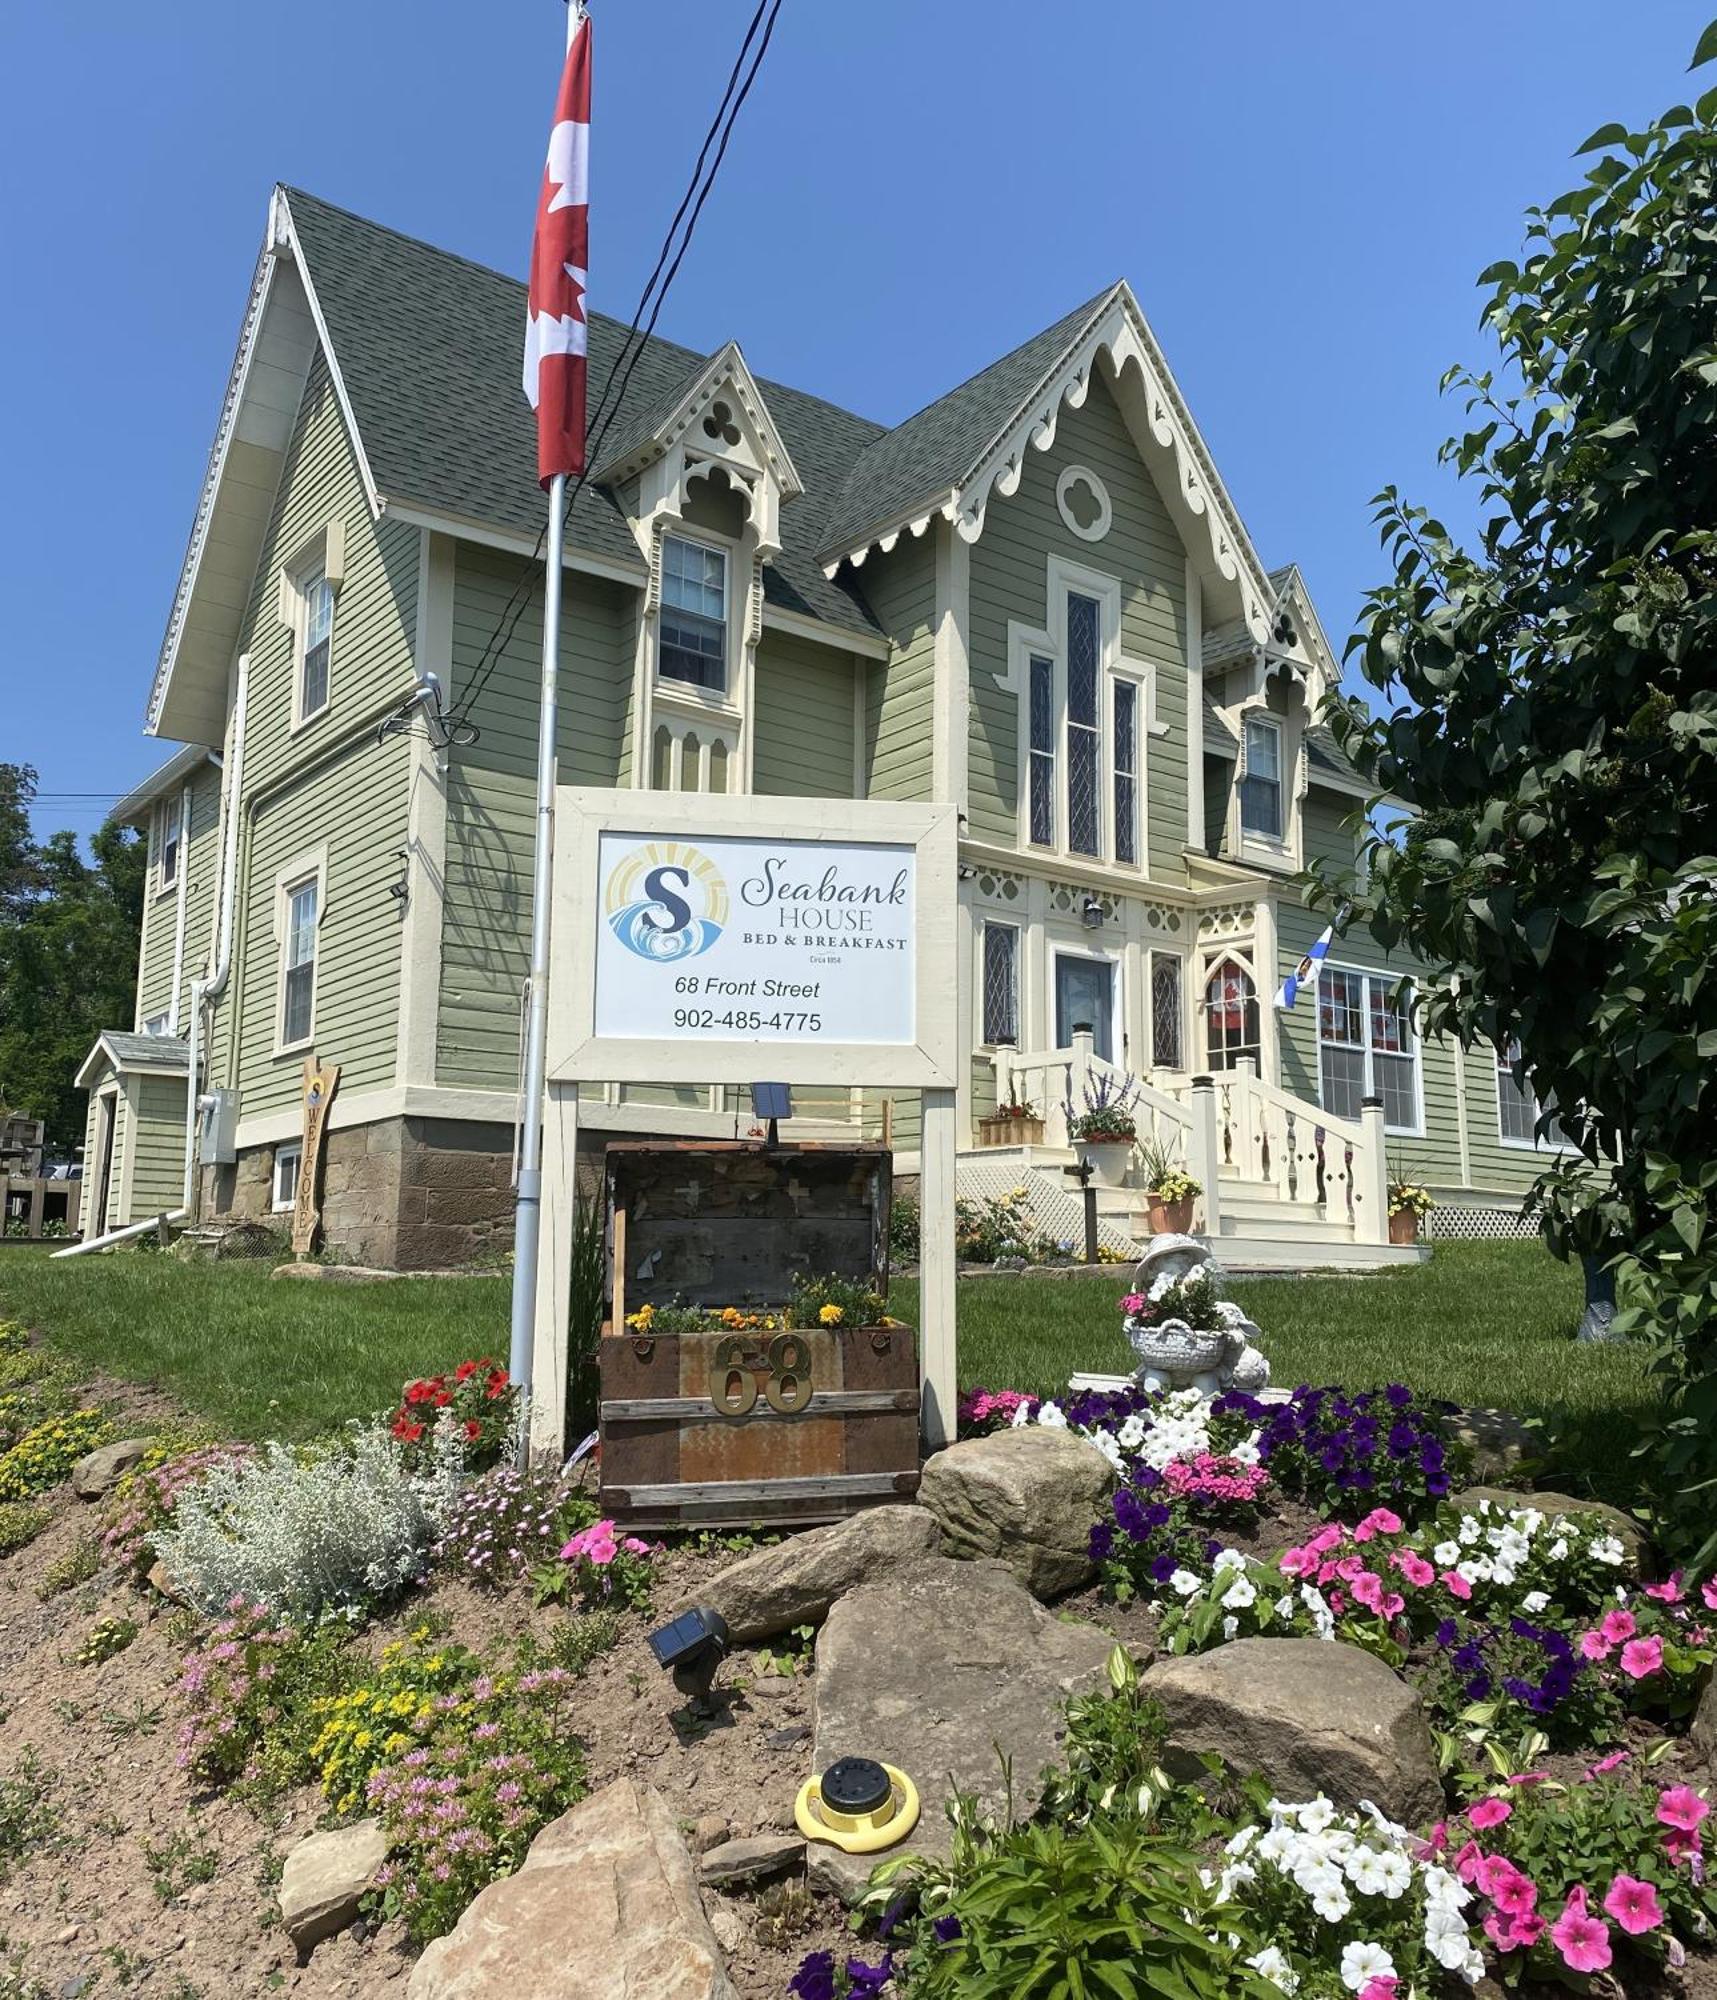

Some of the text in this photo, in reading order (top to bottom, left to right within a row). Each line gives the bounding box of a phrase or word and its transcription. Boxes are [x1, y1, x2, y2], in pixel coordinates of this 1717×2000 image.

[741, 858, 908, 907] Seabank
[779, 907, 873, 932] HOUSE
[743, 933, 908, 950] BED & BREAKFAST
[675, 977, 821, 998] 68 Front Street
[674, 1009, 822, 1032] 902-485-4775
[299, 1107, 321, 1229] WELCOME
[709, 1334, 814, 1416] 68
